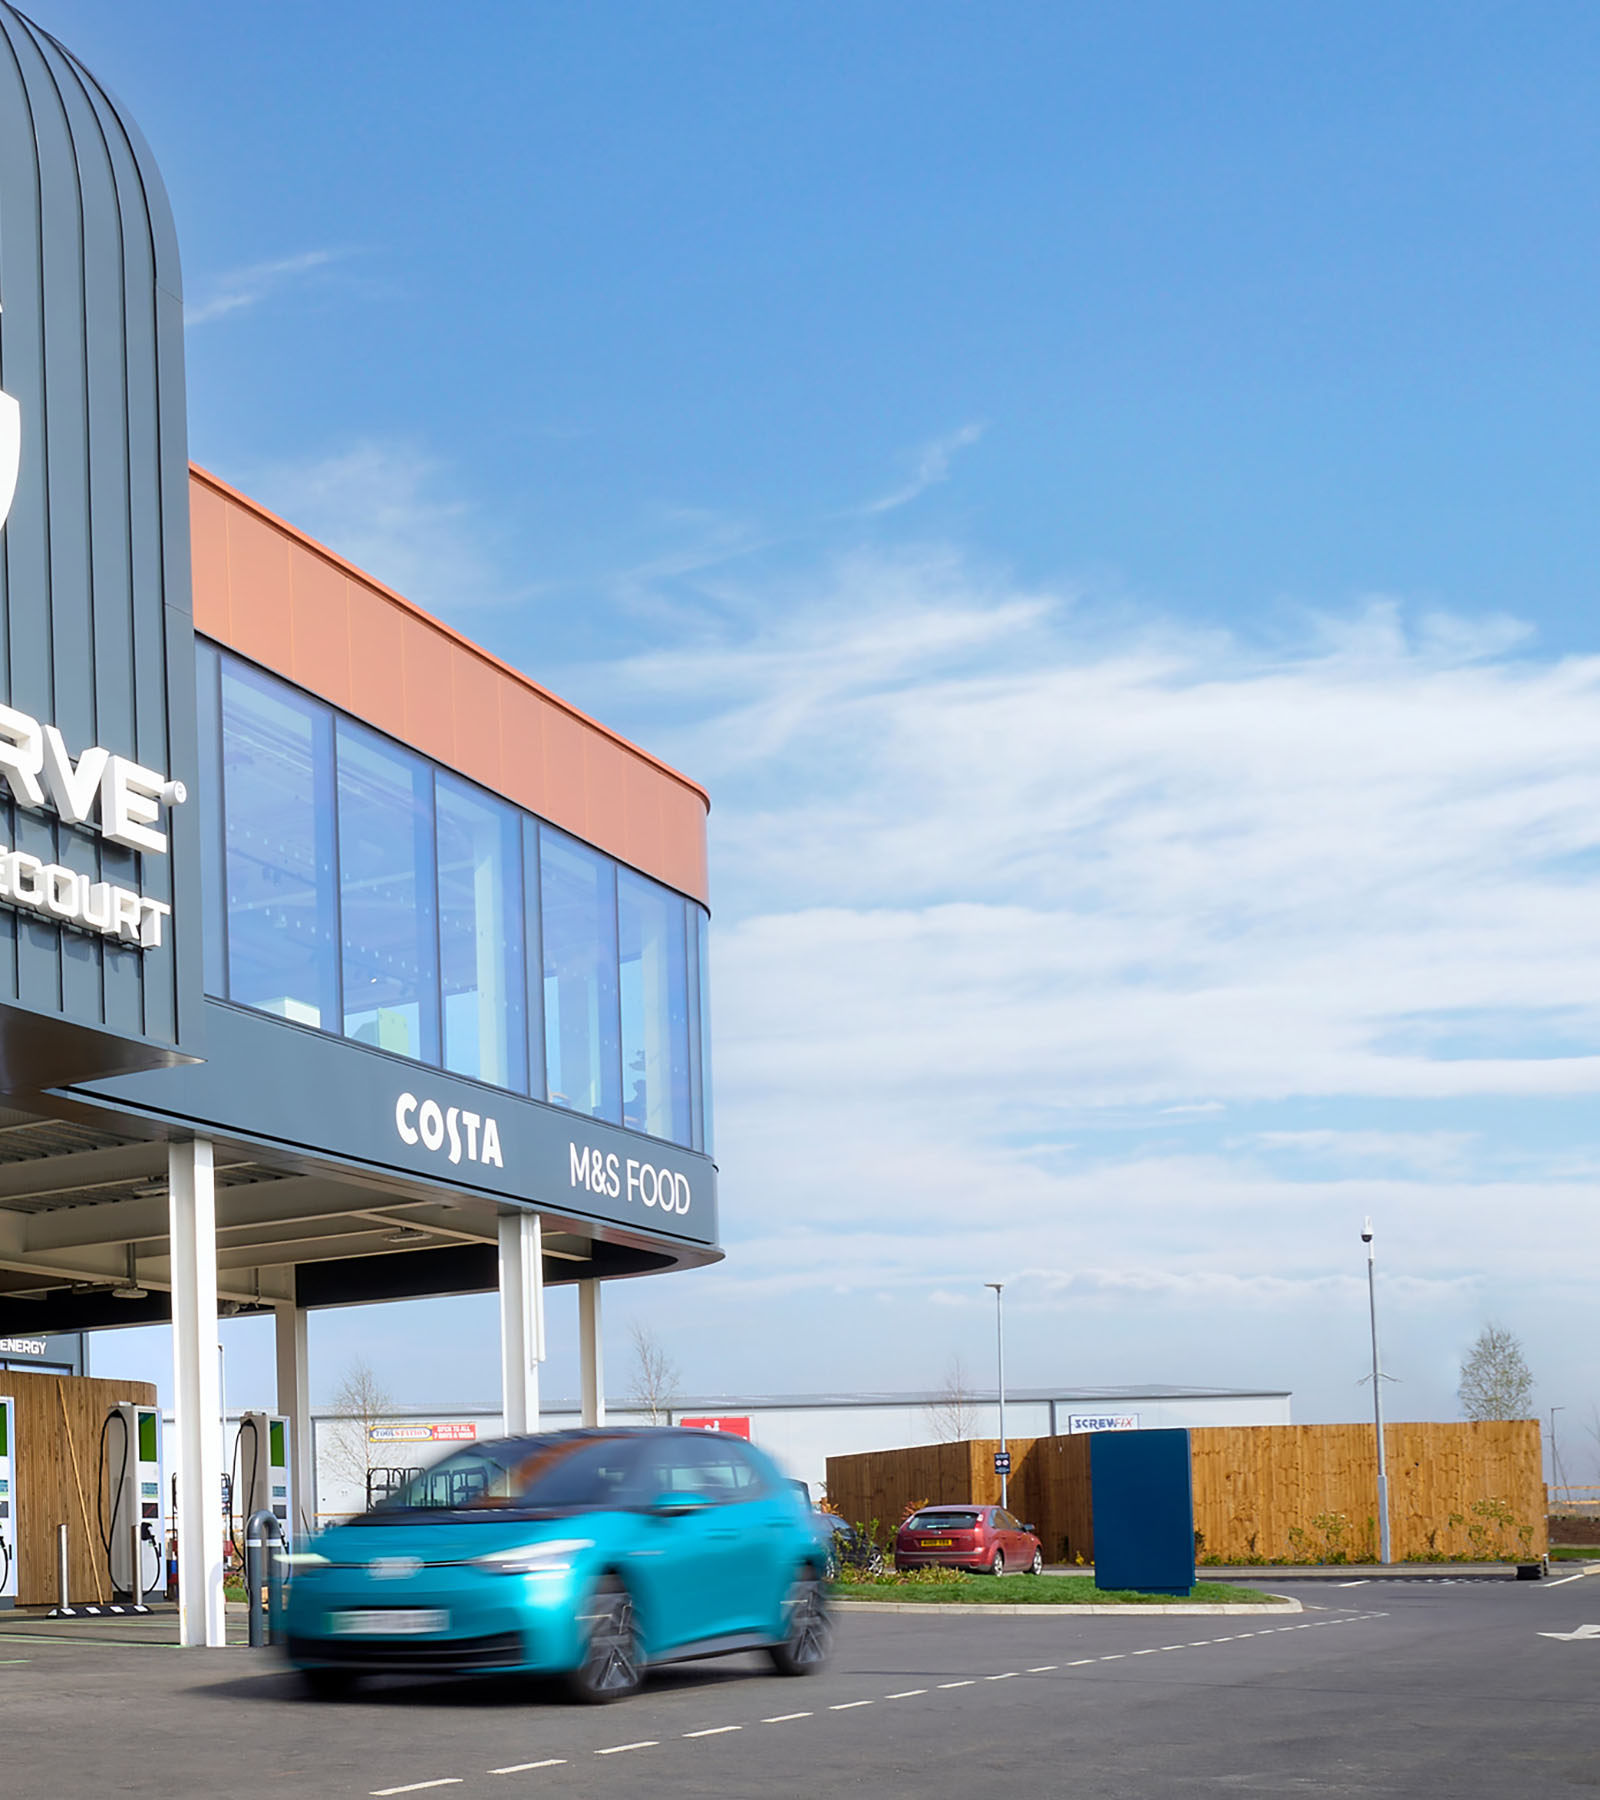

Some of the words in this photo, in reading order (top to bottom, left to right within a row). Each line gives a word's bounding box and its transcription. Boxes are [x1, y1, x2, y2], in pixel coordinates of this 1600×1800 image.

[396, 1092, 504, 1168] COSTA
[569, 1142, 620, 1198] M&S
[626, 1158, 691, 1215] FOOD
[0, 1338, 46, 1355] ENERGY
[1074, 1417, 1134, 1430] SCREWFIX
